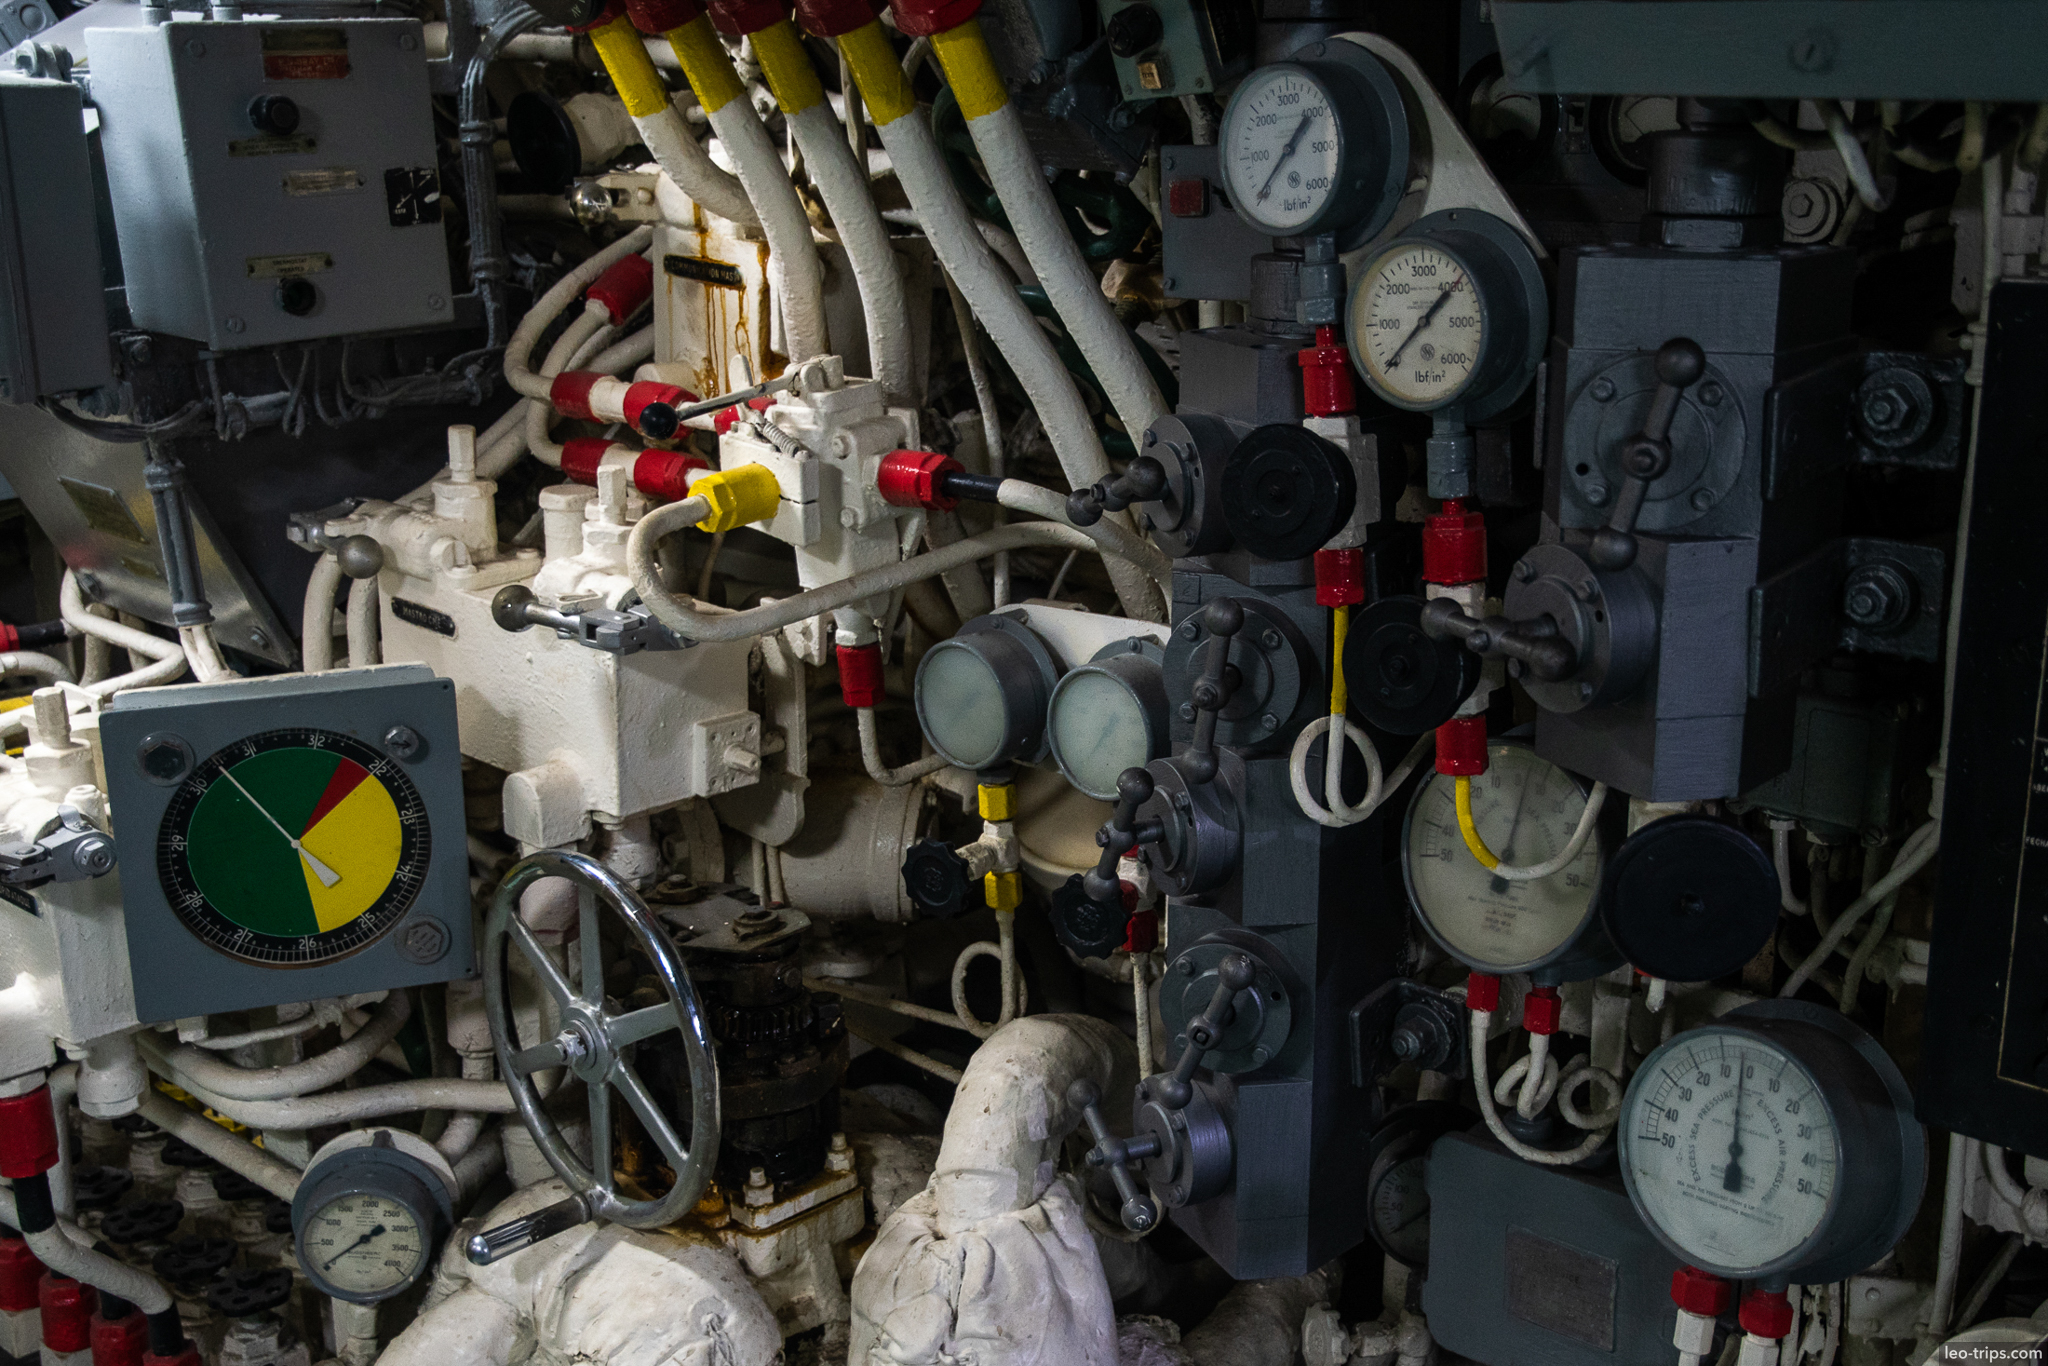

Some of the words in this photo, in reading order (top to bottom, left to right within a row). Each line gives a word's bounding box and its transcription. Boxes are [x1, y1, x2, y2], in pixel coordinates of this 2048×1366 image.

[1278, 93, 1300, 106] 3000
[1301, 106, 1324, 118] 4000
[1256, 114, 1277, 127] 2000
[1312, 140, 1335, 153] 5000
[1251, 150, 1270, 162] 1000
[1306, 177, 1328, 190] 6000
[1411, 265, 1436, 277] 3000
[1386, 283, 1410, 295] 2000
[1438, 281, 1464, 292] 4000
[1379, 319, 1400, 330] 1000
[1449, 317, 1475, 328] 5000
[1441, 353, 1466, 364] 6000
[308, 734, 325, 747] 32
[368, 760, 387, 776] 22
[190, 778, 208, 796] 30
[1491, 775, 1500, 788] 10
[401, 808, 416, 825] 23
[1441, 824, 1455, 838] 40
[171, 834, 184, 851] 29
[1440, 849, 1453, 862] 50
[396, 865, 412, 882] 24
[1565, 873, 1580, 887] 50
[186, 891, 203, 908] 28
[358, 911, 376, 928] 25
[233, 928, 254, 943] 27
[298, 937, 317, 950] 26
[1720, 1064, 1731, 1078] 10
[1746, 1065, 1754, 1079] 0
[1696, 1071, 1710, 1087] 20
[1769, 1078, 1780, 1093] 10
[1678, 1086, 1692, 1101] 30
[1698, 1090, 1735, 1120] PRESSURE
[1785, 1099, 1800, 1114] 20
[1665, 1107, 1679, 1122] 40
[1689, 1123, 1700, 1140] SEA
[1757, 1099, 1782, 1134] EXCESS
[1778, 1139, 1787, 1156] AIR
[1797, 1123, 1812, 1140] 30
[1661, 1132, 1675, 1148] 50
[1689, 1144, 1701, 1182] EXCESS
[1802, 1152, 1817, 1168] 40
[1394, 1184, 1410, 1194] 100
[1797, 1178, 1812, 1194] 50
[338, 1205, 354, 1213] 1500
[362, 1200, 379, 1208] 2000
[1391, 1202, 1403, 1212] 50
[383, 1210, 400, 1218] 2500
[326, 1218, 342, 1226] 1000
[391, 1225, 409, 1233] 3000
[321, 1238, 334, 1246] 500
[392, 1244, 409, 1252] 3500
